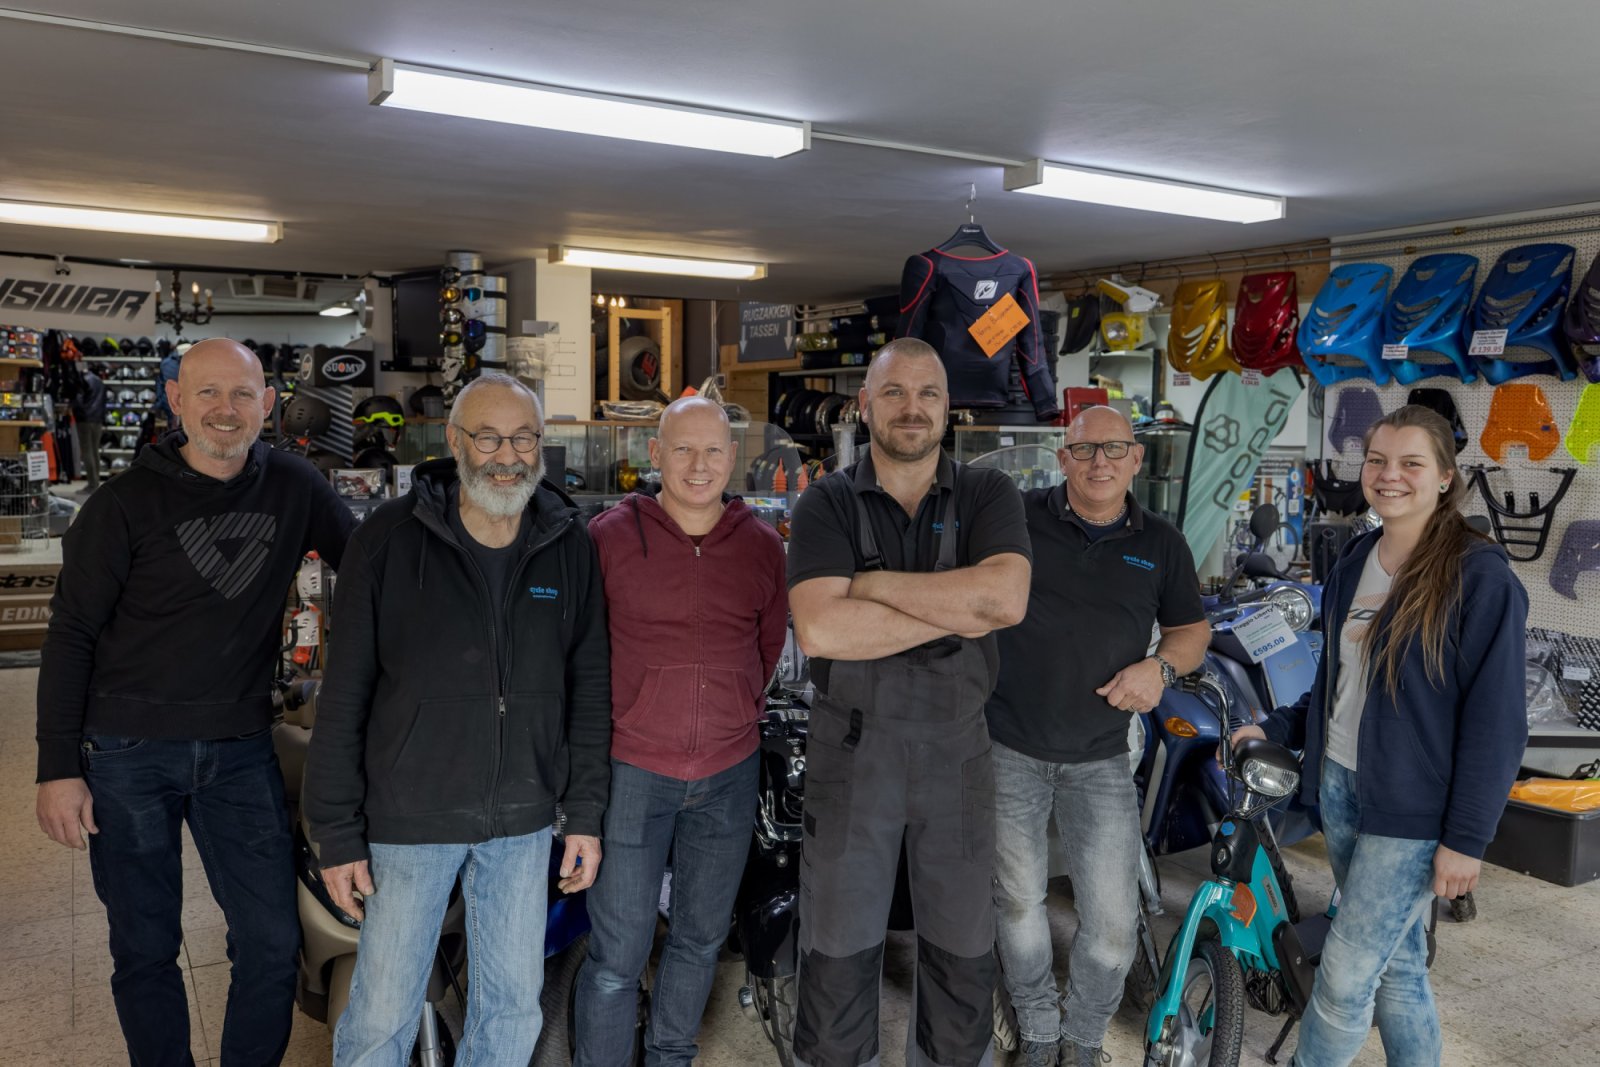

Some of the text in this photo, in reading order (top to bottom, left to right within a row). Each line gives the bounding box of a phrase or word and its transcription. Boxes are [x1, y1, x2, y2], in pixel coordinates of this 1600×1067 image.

[743, 304, 792, 322] RUGZAKKEN
[750, 323, 780, 338] TASSEN
[326, 362, 361, 374] SUOMY
[1233, 607, 1274, 631] Piaggio Liberty
[1253, 636, 1285, 657] €595.00
